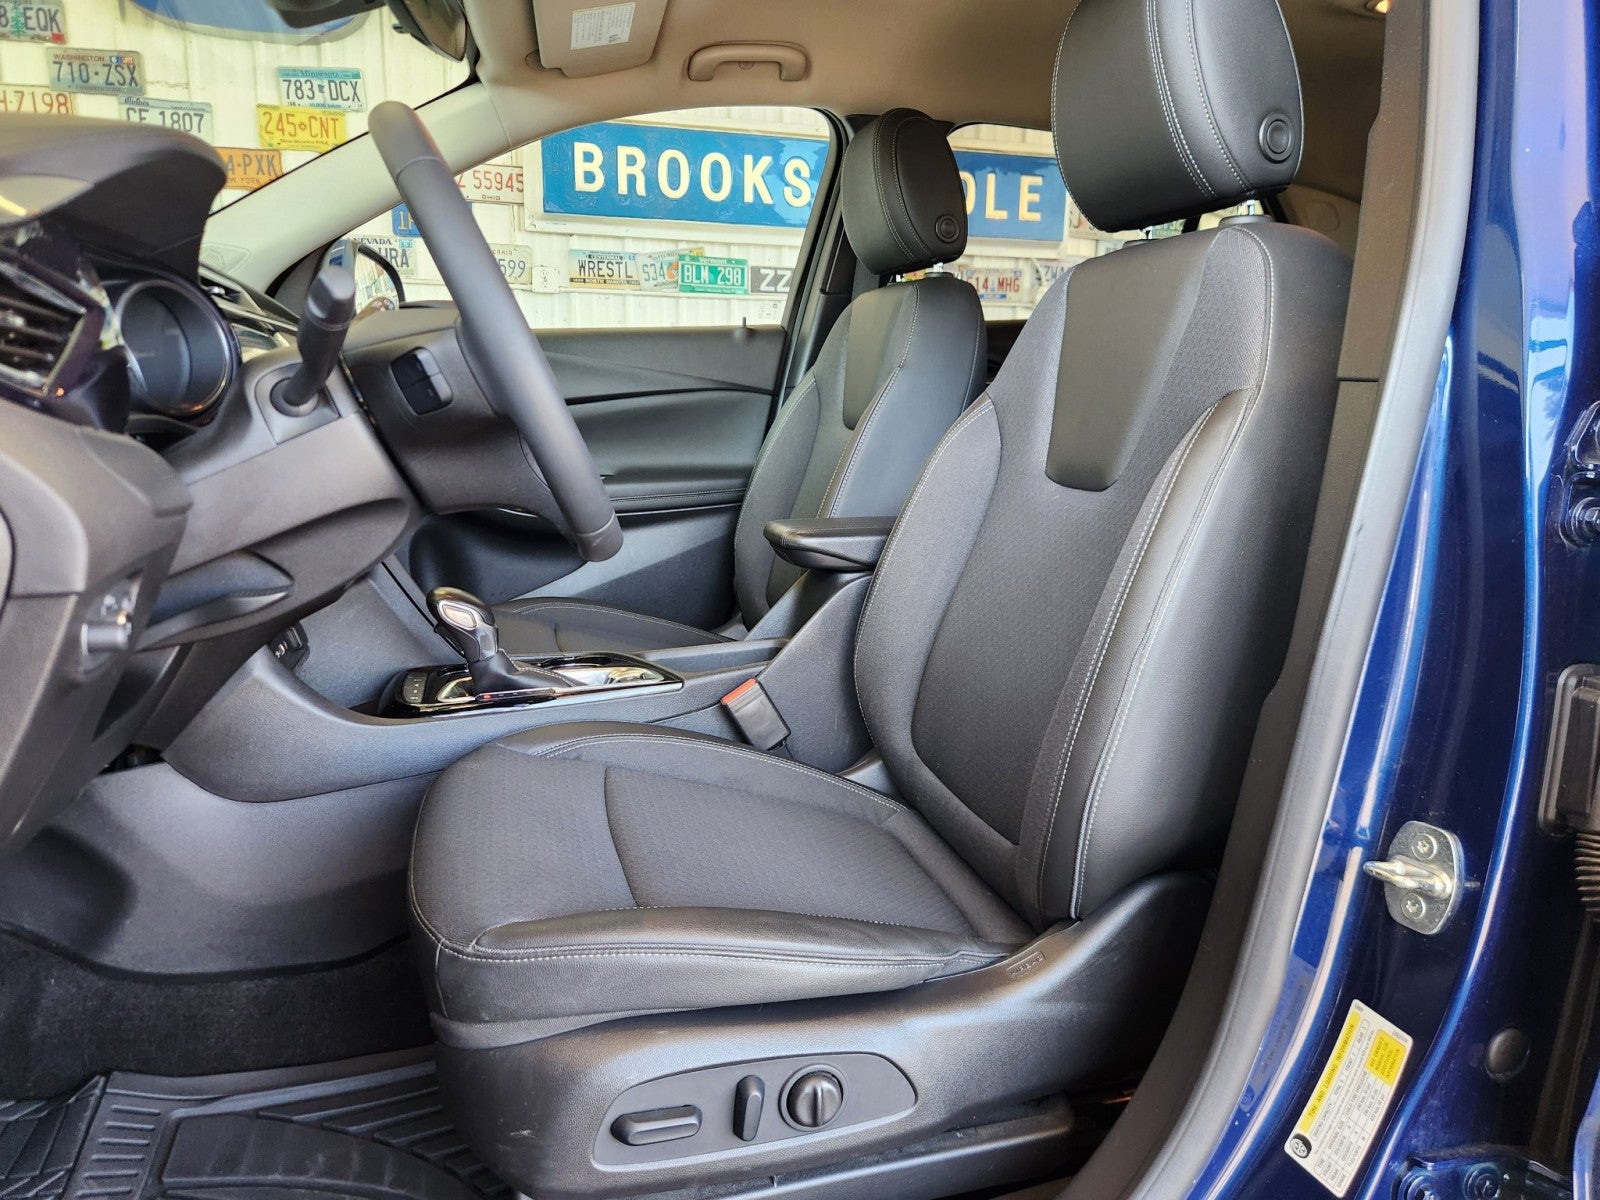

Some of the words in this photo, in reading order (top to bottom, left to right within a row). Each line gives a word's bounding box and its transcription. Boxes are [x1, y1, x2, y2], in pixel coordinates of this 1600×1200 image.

[23, 7, 61, 32] EQK
[282, 80, 315, 100] 783
[328, 80, 360, 102] DCX
[159, 110, 204, 133] 1807
[263, 111, 297, 137] 245
[308, 115, 339, 139] CNT
[473, 170, 524, 193] 55945
[574, 142, 812, 207] BROOKS
[578, 260, 633, 278] WRESTL
